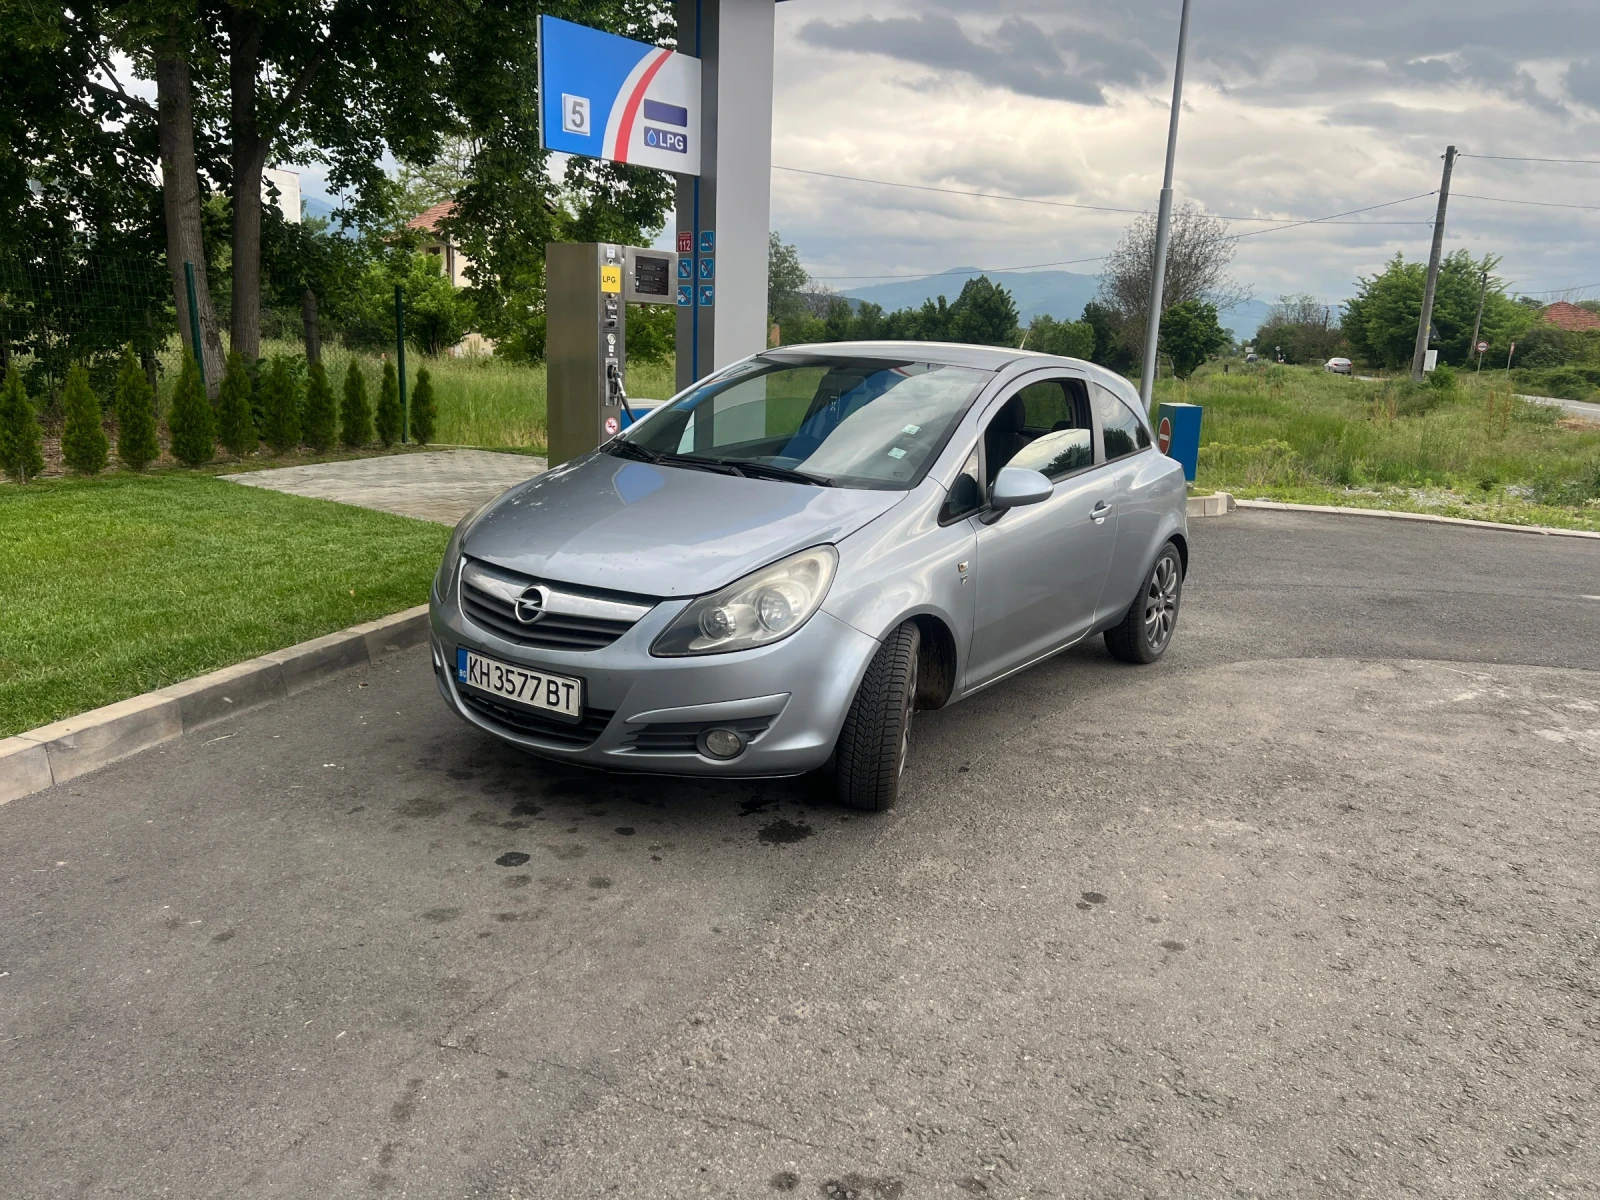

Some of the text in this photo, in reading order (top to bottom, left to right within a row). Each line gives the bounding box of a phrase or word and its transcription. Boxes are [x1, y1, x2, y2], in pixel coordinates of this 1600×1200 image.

[571, 101, 584, 128] 5
[659, 131, 684, 151] LPG
[679, 239, 691, 251] 112
[602, 275, 616, 284] LPG
[459, 669, 466, 678] BG
